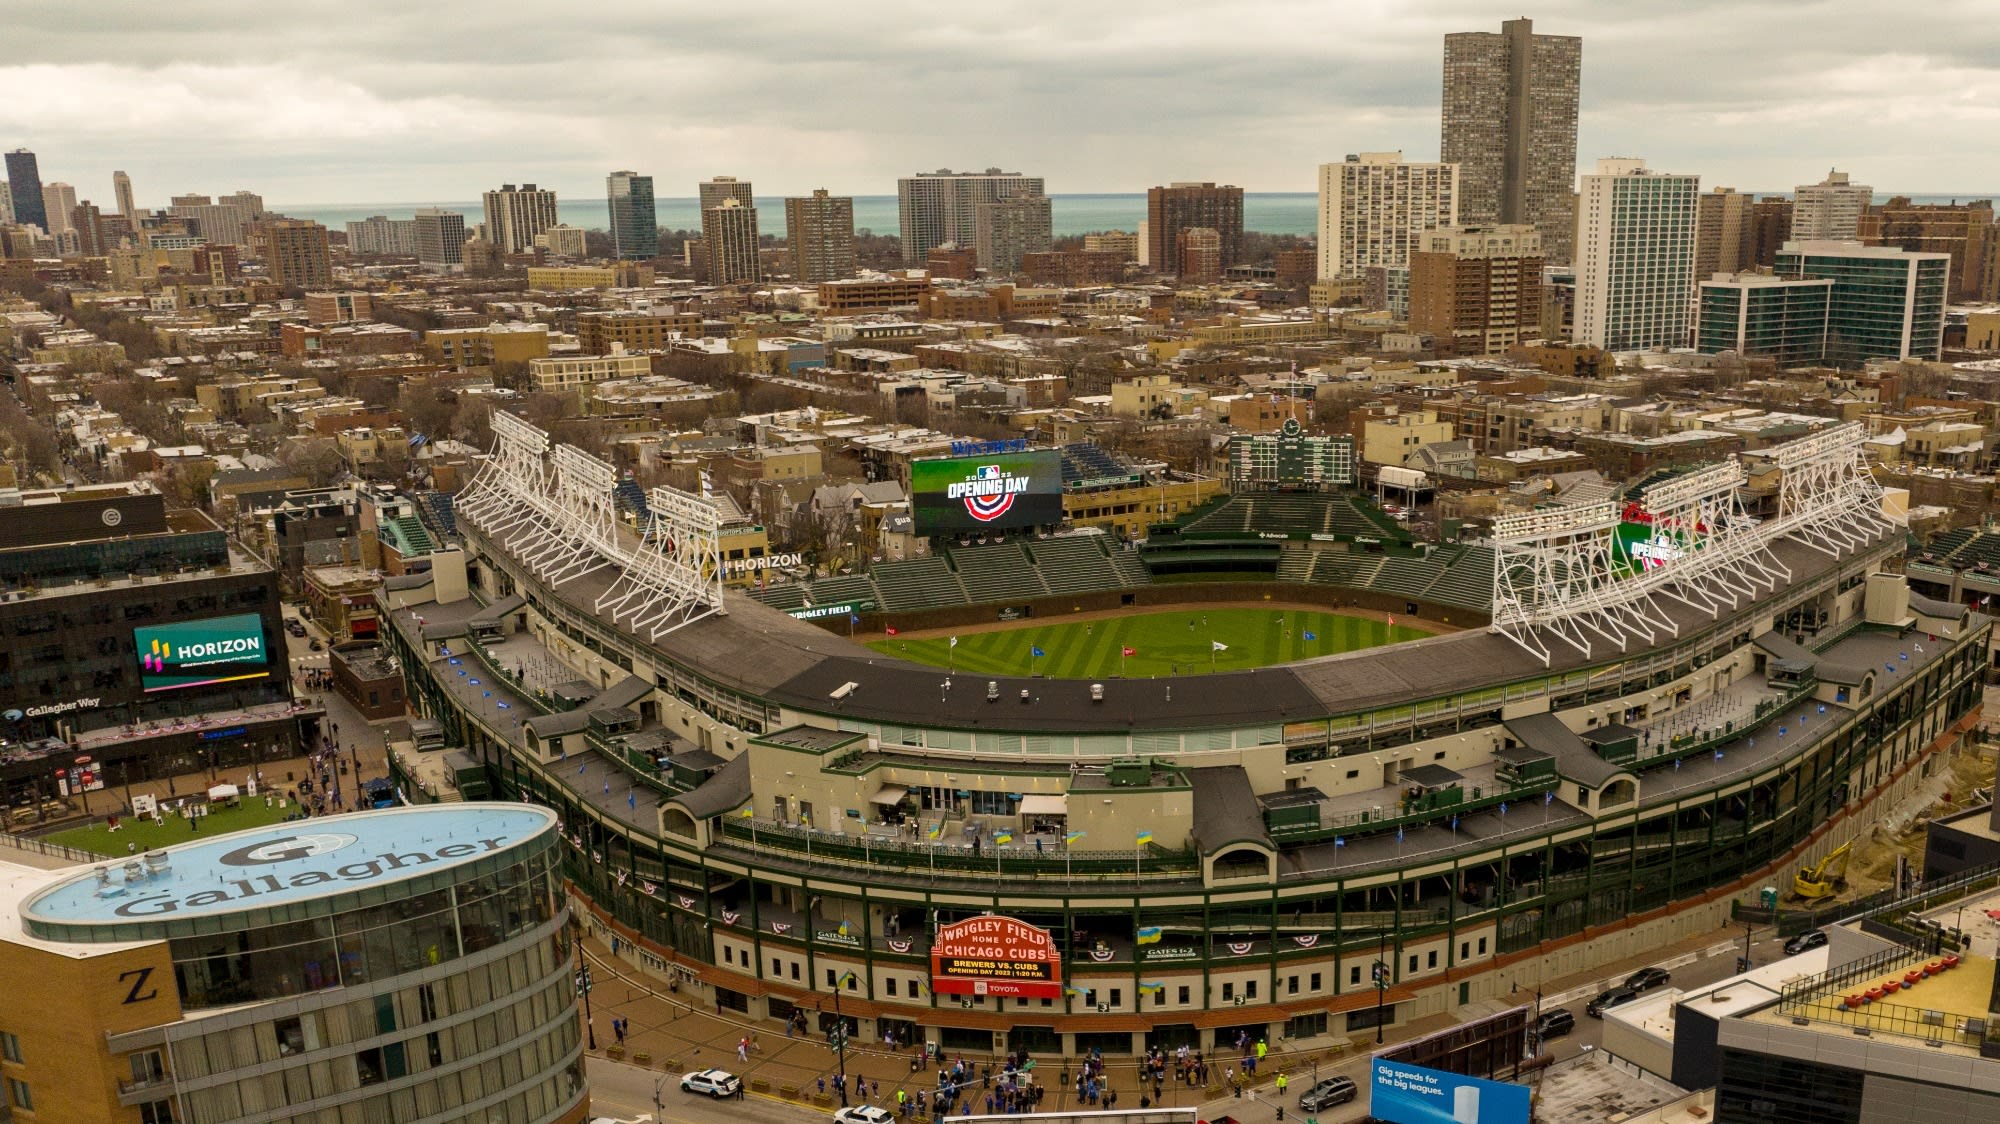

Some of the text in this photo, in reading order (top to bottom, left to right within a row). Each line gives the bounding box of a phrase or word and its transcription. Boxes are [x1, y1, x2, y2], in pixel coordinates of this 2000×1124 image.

[948, 476, 1029, 499] OPENING DAY
[735, 552, 802, 572] HORIZON
[828, 605, 851, 615] FIELD
[178, 636, 260, 659] HORIZON
[26, 698, 100, 717] Gallagher Way
[114, 835, 508, 918] Gallagher
[944, 921, 1045, 945] WRIGLEY FIELD
[972, 935, 1018, 945] HOME OF
[945, 945, 1046, 960] CHICAGO CUBS
[948, 967, 979, 975] OPENING
[953, 960, 1038, 971] BREWERS VS. CUBS
[118, 967, 158, 1005] Z
[989, 985, 1020, 993] TOYOTA
[1378, 1066, 1438, 1084] Gig speeds for
[1378, 1075, 1444, 1095] the big leagues.
